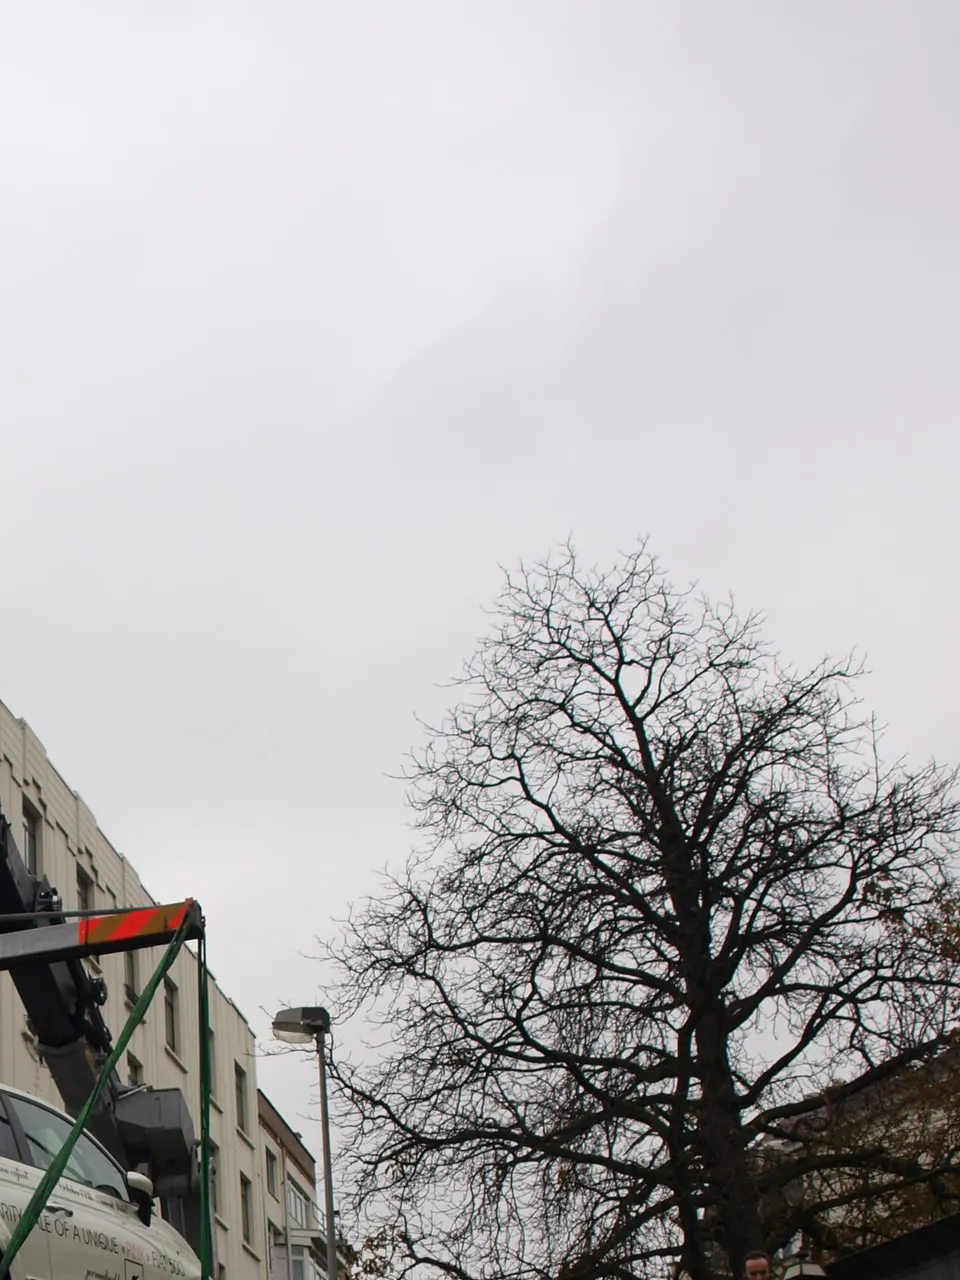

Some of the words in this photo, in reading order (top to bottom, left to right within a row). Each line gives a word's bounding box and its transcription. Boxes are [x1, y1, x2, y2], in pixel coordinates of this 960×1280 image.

[54, 1216, 69, 1238] OF
[73, 1223, 81, 1239] A
[82, 1226, 119, 1256] UNIQUE
